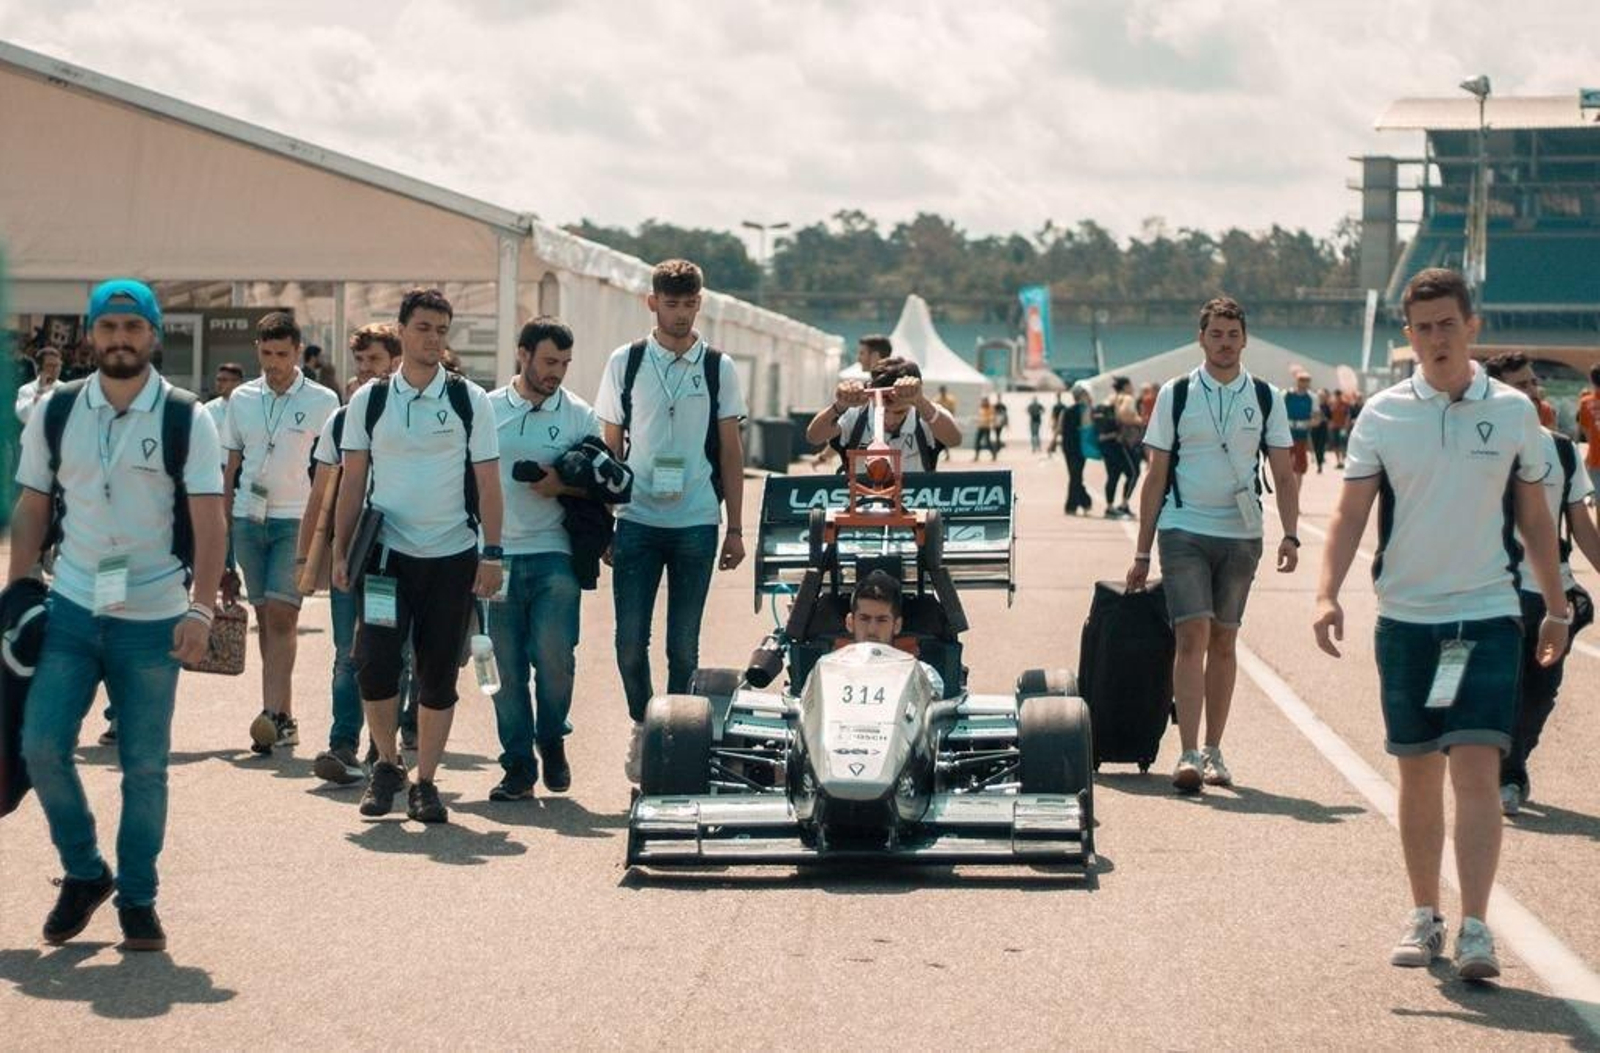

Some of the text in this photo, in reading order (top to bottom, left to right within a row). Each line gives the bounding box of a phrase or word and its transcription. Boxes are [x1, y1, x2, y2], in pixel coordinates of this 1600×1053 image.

[789, 485, 1006, 508] LAS GALICIA
[841, 684, 886, 705] 314
